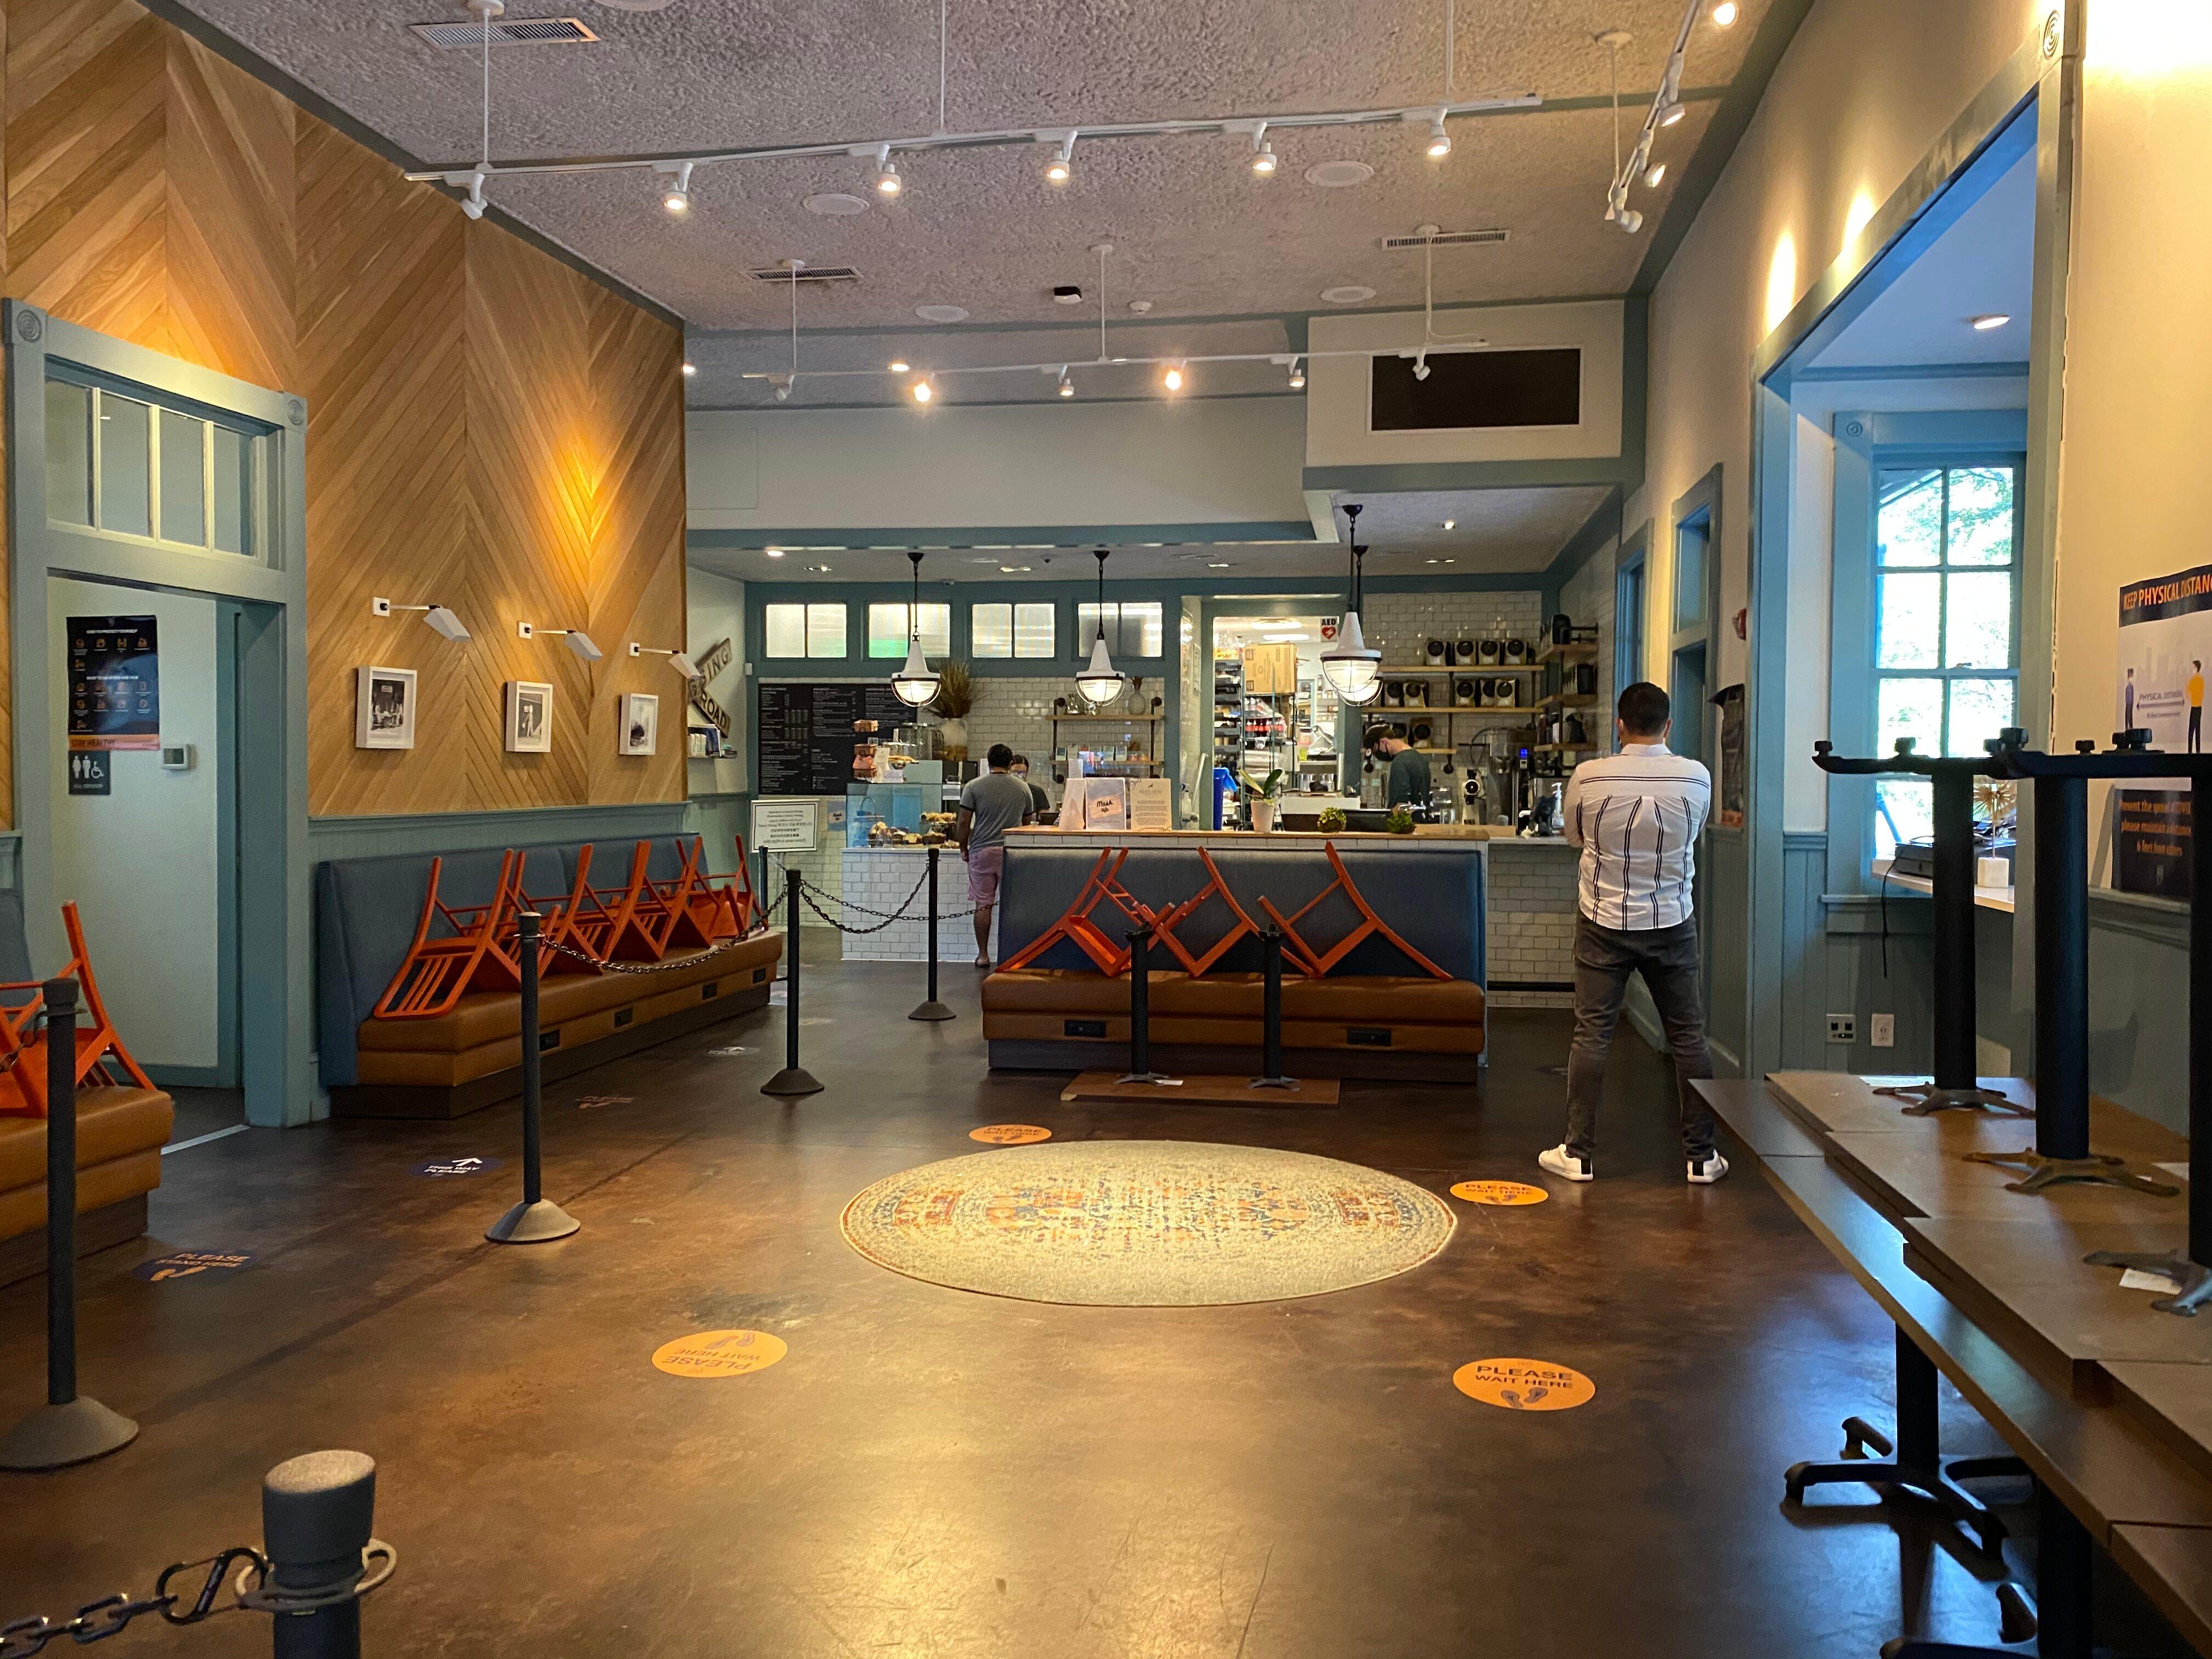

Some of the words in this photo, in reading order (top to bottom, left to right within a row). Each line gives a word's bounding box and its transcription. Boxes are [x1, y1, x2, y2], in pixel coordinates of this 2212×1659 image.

[2124, 591, 2137, 610] KEEP
[2138, 582, 2180, 607] PHYSICAL
[2140, 692, 2163, 701] PHYSICAL
[700, 689, 727, 728] ROAD
[674, 1348, 719, 1357] HERE
[720, 1352, 761, 1361] WAIT
[661, 1356, 752, 1370] PLEASE
[1477, 1365, 1573, 1380] PLEASE
[1475, 1375, 1518, 1385] WAIT
[1525, 1379, 1573, 1389] HERE
